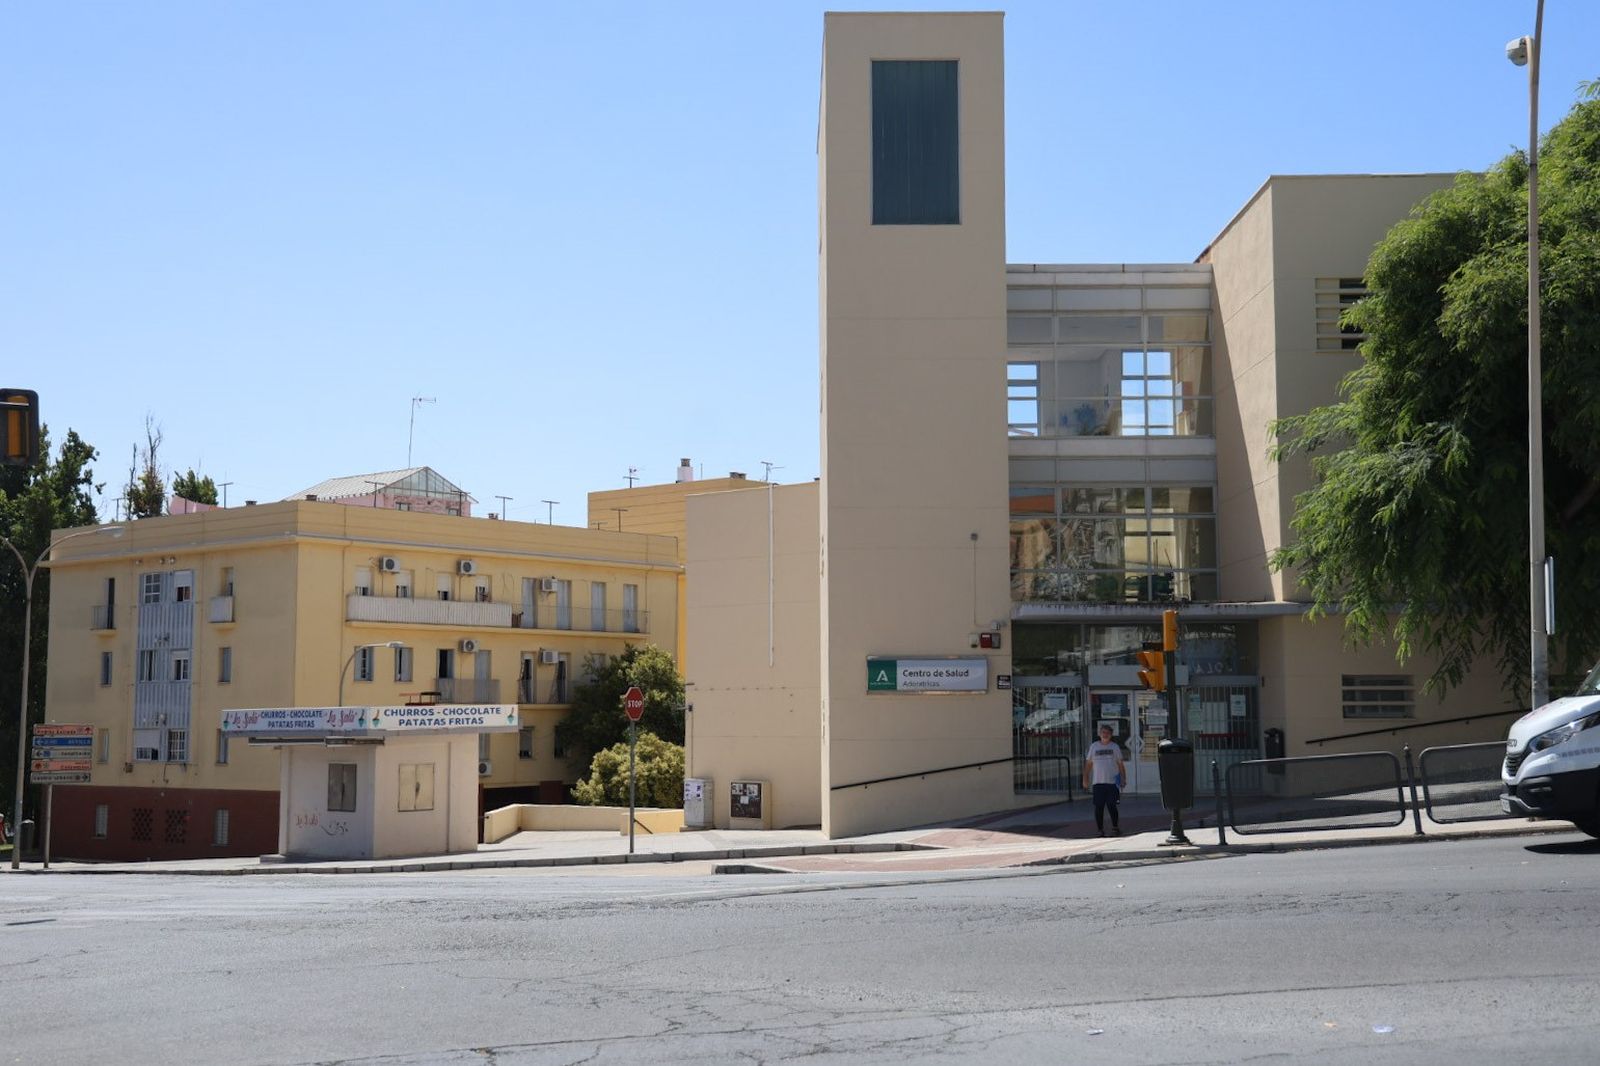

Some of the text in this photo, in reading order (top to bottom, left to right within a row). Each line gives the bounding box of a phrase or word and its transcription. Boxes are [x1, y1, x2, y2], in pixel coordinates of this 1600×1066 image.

[902, 669, 969, 678] Centro de Salud
[627, 700, 643, 708] STOP
[260, 711, 286, 719] CHURROS
[289, 710, 323, 719] CHOCOLATE
[383, 708, 435, 717] CHURROS
[442, 707, 501, 716] CHOCOLATE
[267, 720, 315, 729] PATATAS FRITAS
[398, 717, 484, 727] PATATAS FRITAS
